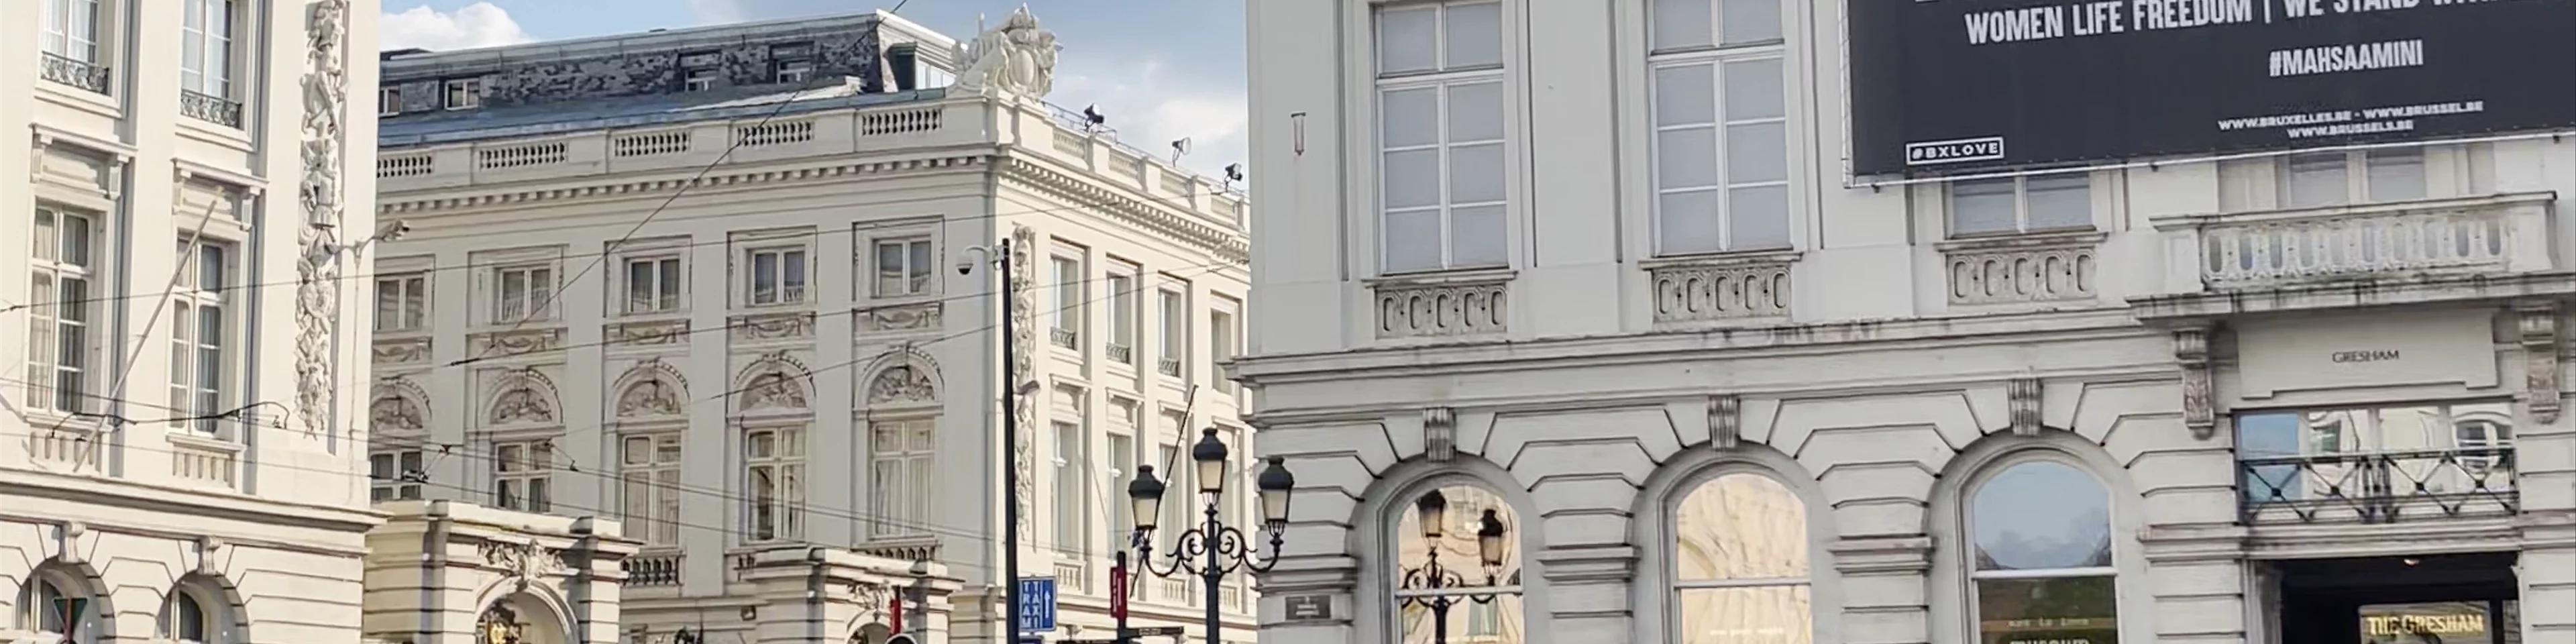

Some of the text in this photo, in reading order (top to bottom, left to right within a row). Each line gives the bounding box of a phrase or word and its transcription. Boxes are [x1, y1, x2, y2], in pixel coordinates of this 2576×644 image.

[1964, 6, 2063, 44] WOMEN
[2072, 1, 2124, 36] LIFE
[2133, 0, 2252, 30] FREEDOM
[2269, 39, 2424, 77] #MAHSAAMINI
[2218, 110, 2352, 130] WWW.BRUXELLES.BE
[2363, 101, 2483, 119] WWW.BRUSSEL.BE
[2287, 119, 2414, 138] WWW.BRUSSELS.BE
[1912, 142, 1998, 160] #BXLOVE
[2332, 349, 2400, 363] GRESHAM
[2367, 614, 2485, 635] THE GRESHAM
